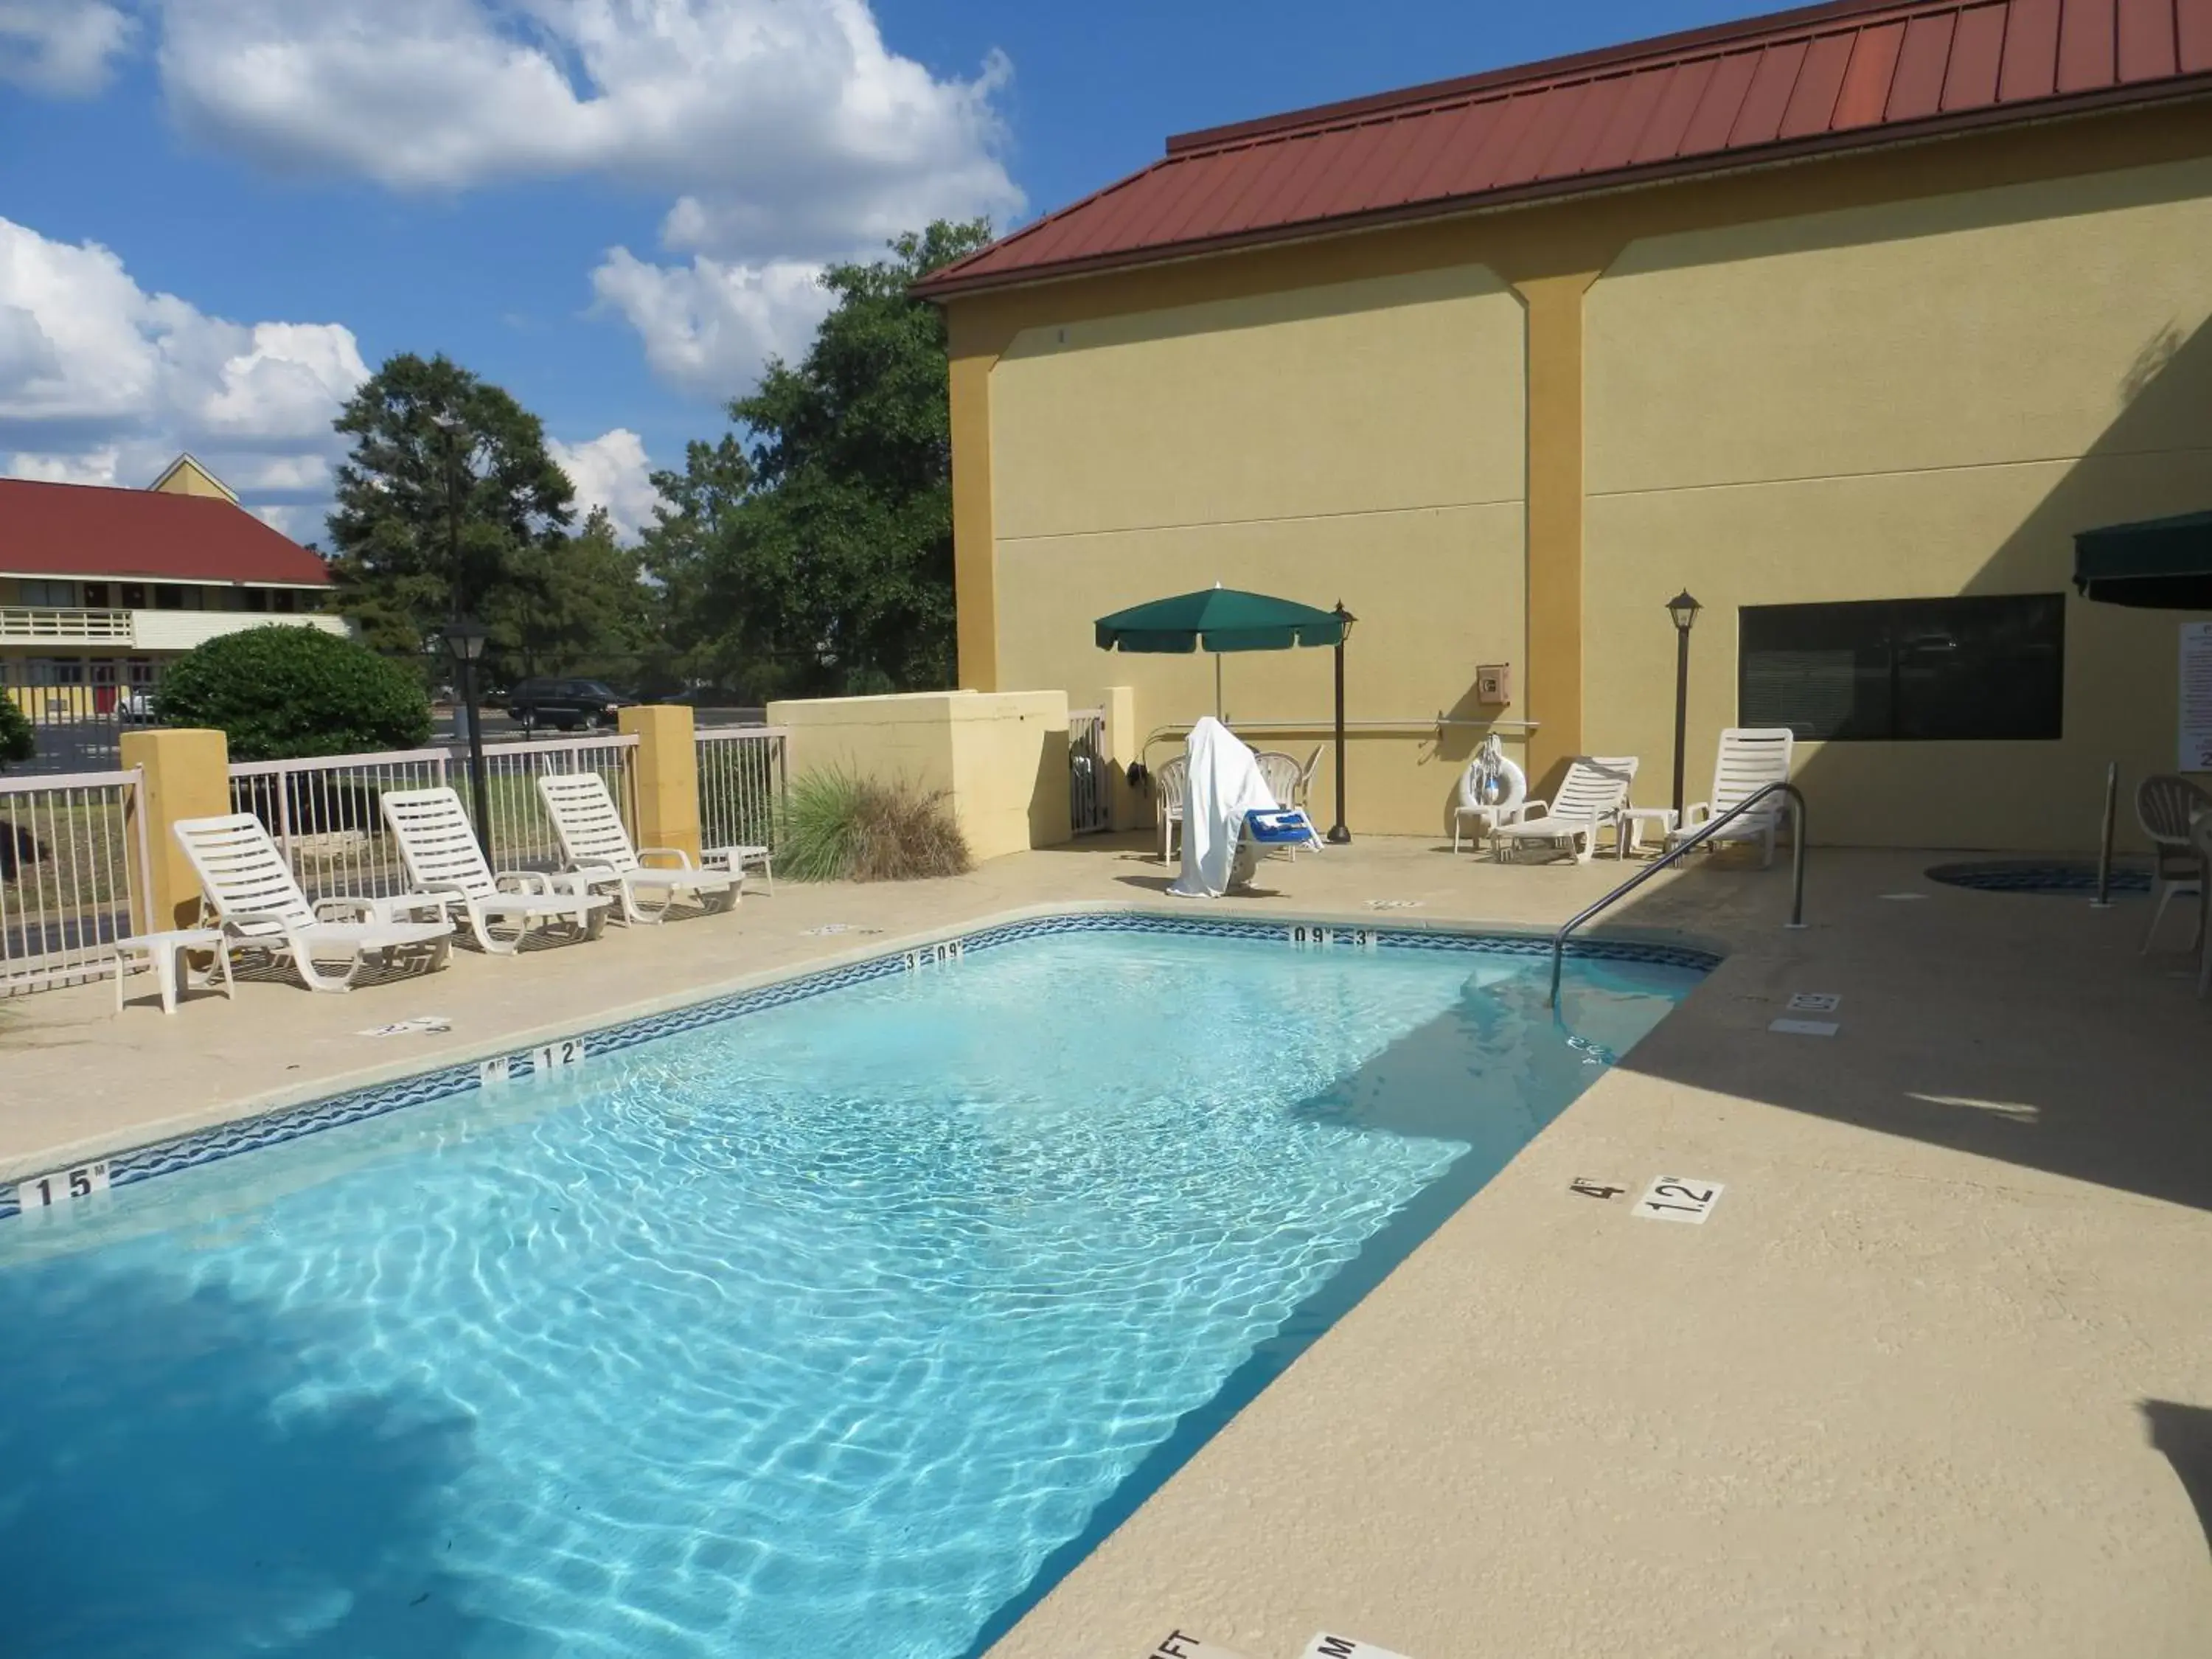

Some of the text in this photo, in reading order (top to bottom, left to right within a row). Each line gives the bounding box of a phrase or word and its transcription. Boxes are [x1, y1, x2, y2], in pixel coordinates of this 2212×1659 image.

[1569, 1184, 1626, 1200] 4
[1158, 1629, 1201, 1659] FT
[1316, 1635, 1357, 1659] M
